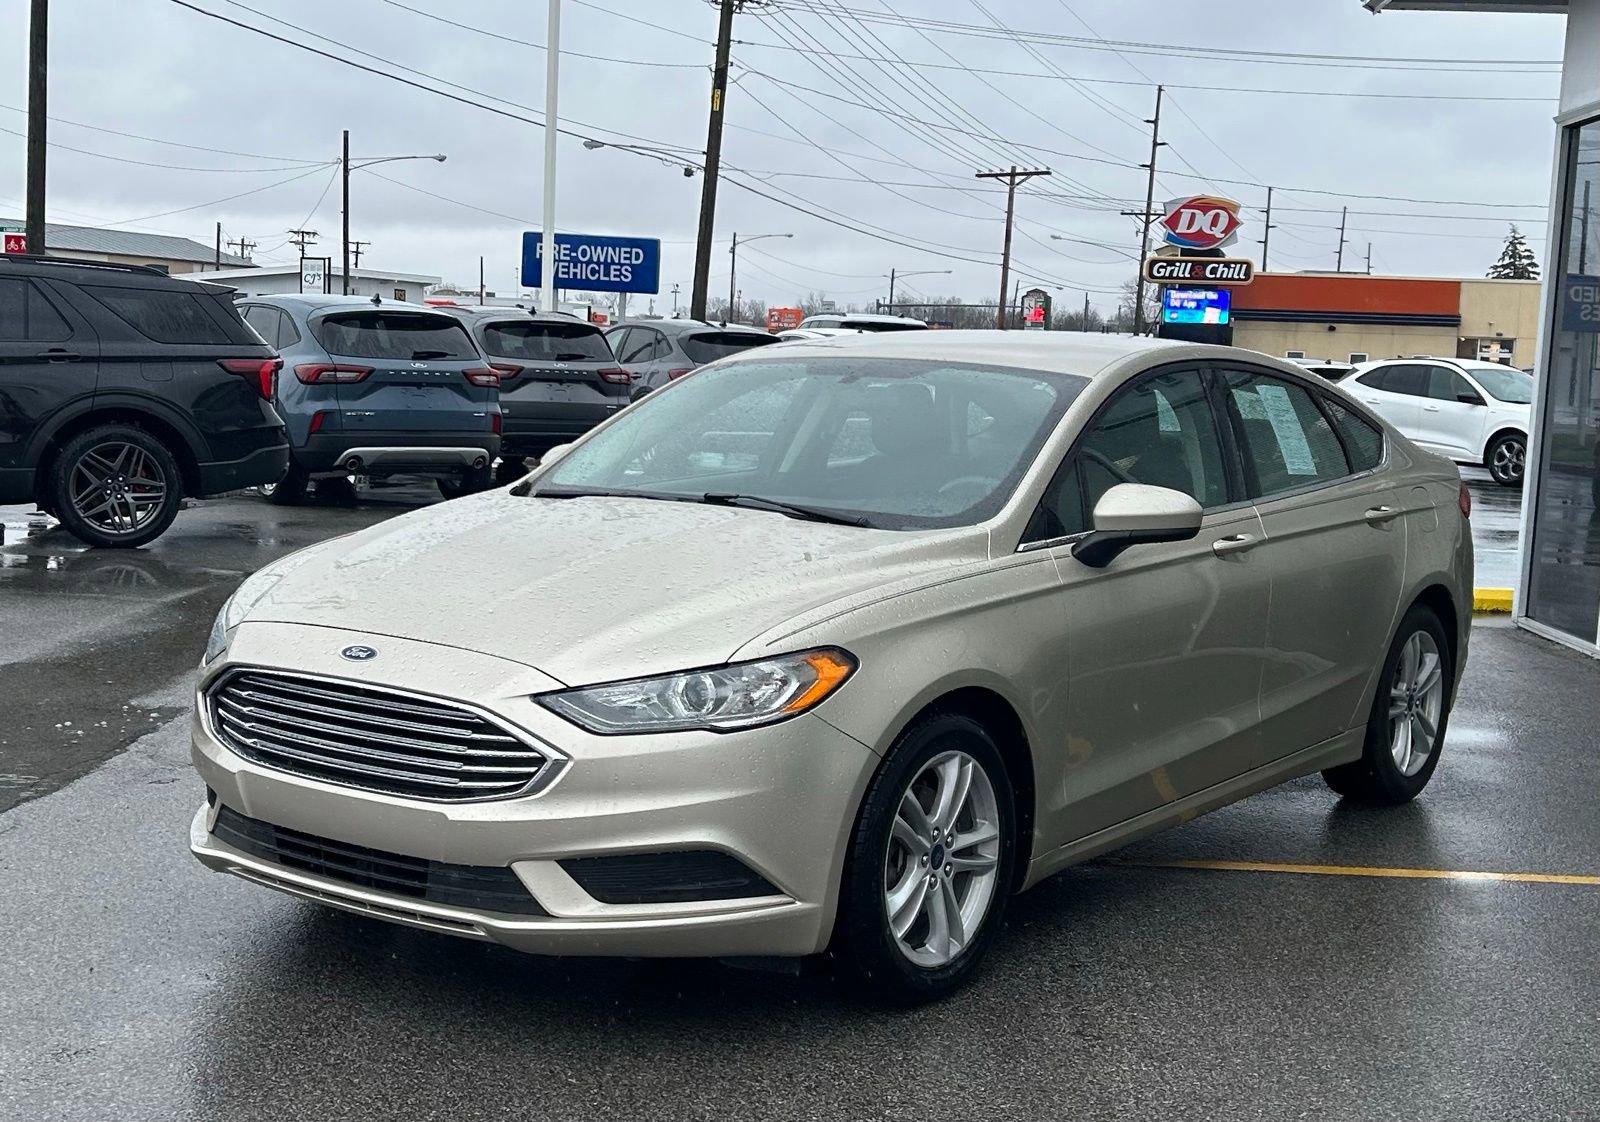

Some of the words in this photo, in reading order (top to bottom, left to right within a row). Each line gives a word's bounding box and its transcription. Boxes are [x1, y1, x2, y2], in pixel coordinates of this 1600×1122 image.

[1175, 208, 1230, 239] DQ
[1152, 262, 1193, 278] Grill
[1205, 263, 1248, 279] Chill
